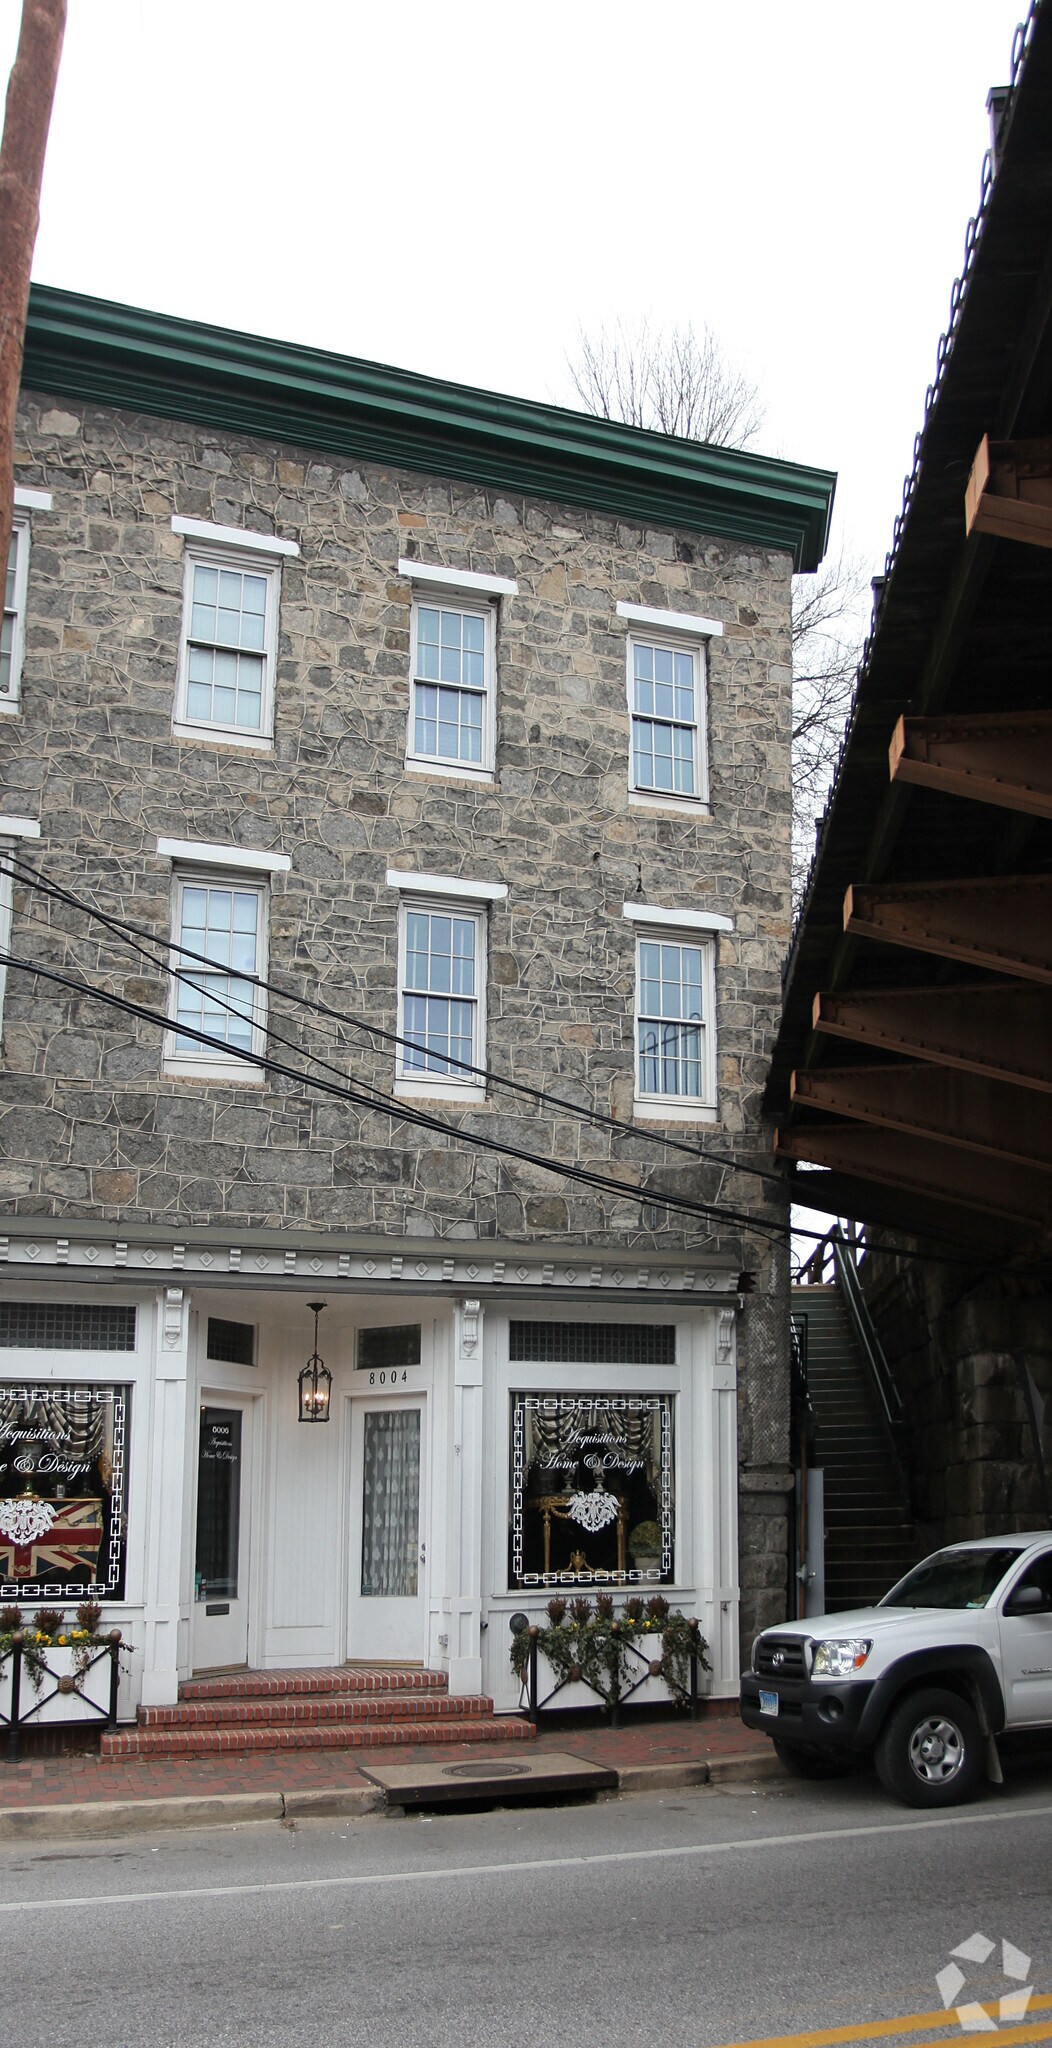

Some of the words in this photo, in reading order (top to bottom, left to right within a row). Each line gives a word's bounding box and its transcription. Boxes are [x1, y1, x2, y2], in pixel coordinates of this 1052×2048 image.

[369, 1370, 407, 1385] 8004
[559, 1426, 627, 1449] Acquisitions
[14, 1453, 34, 1473] &
[36, 1453, 92, 1481] Design
[540, 1451, 579, 1469] Home
[583, 1452, 600, 1469] &
[602, 1452, 644, 1475] Design
